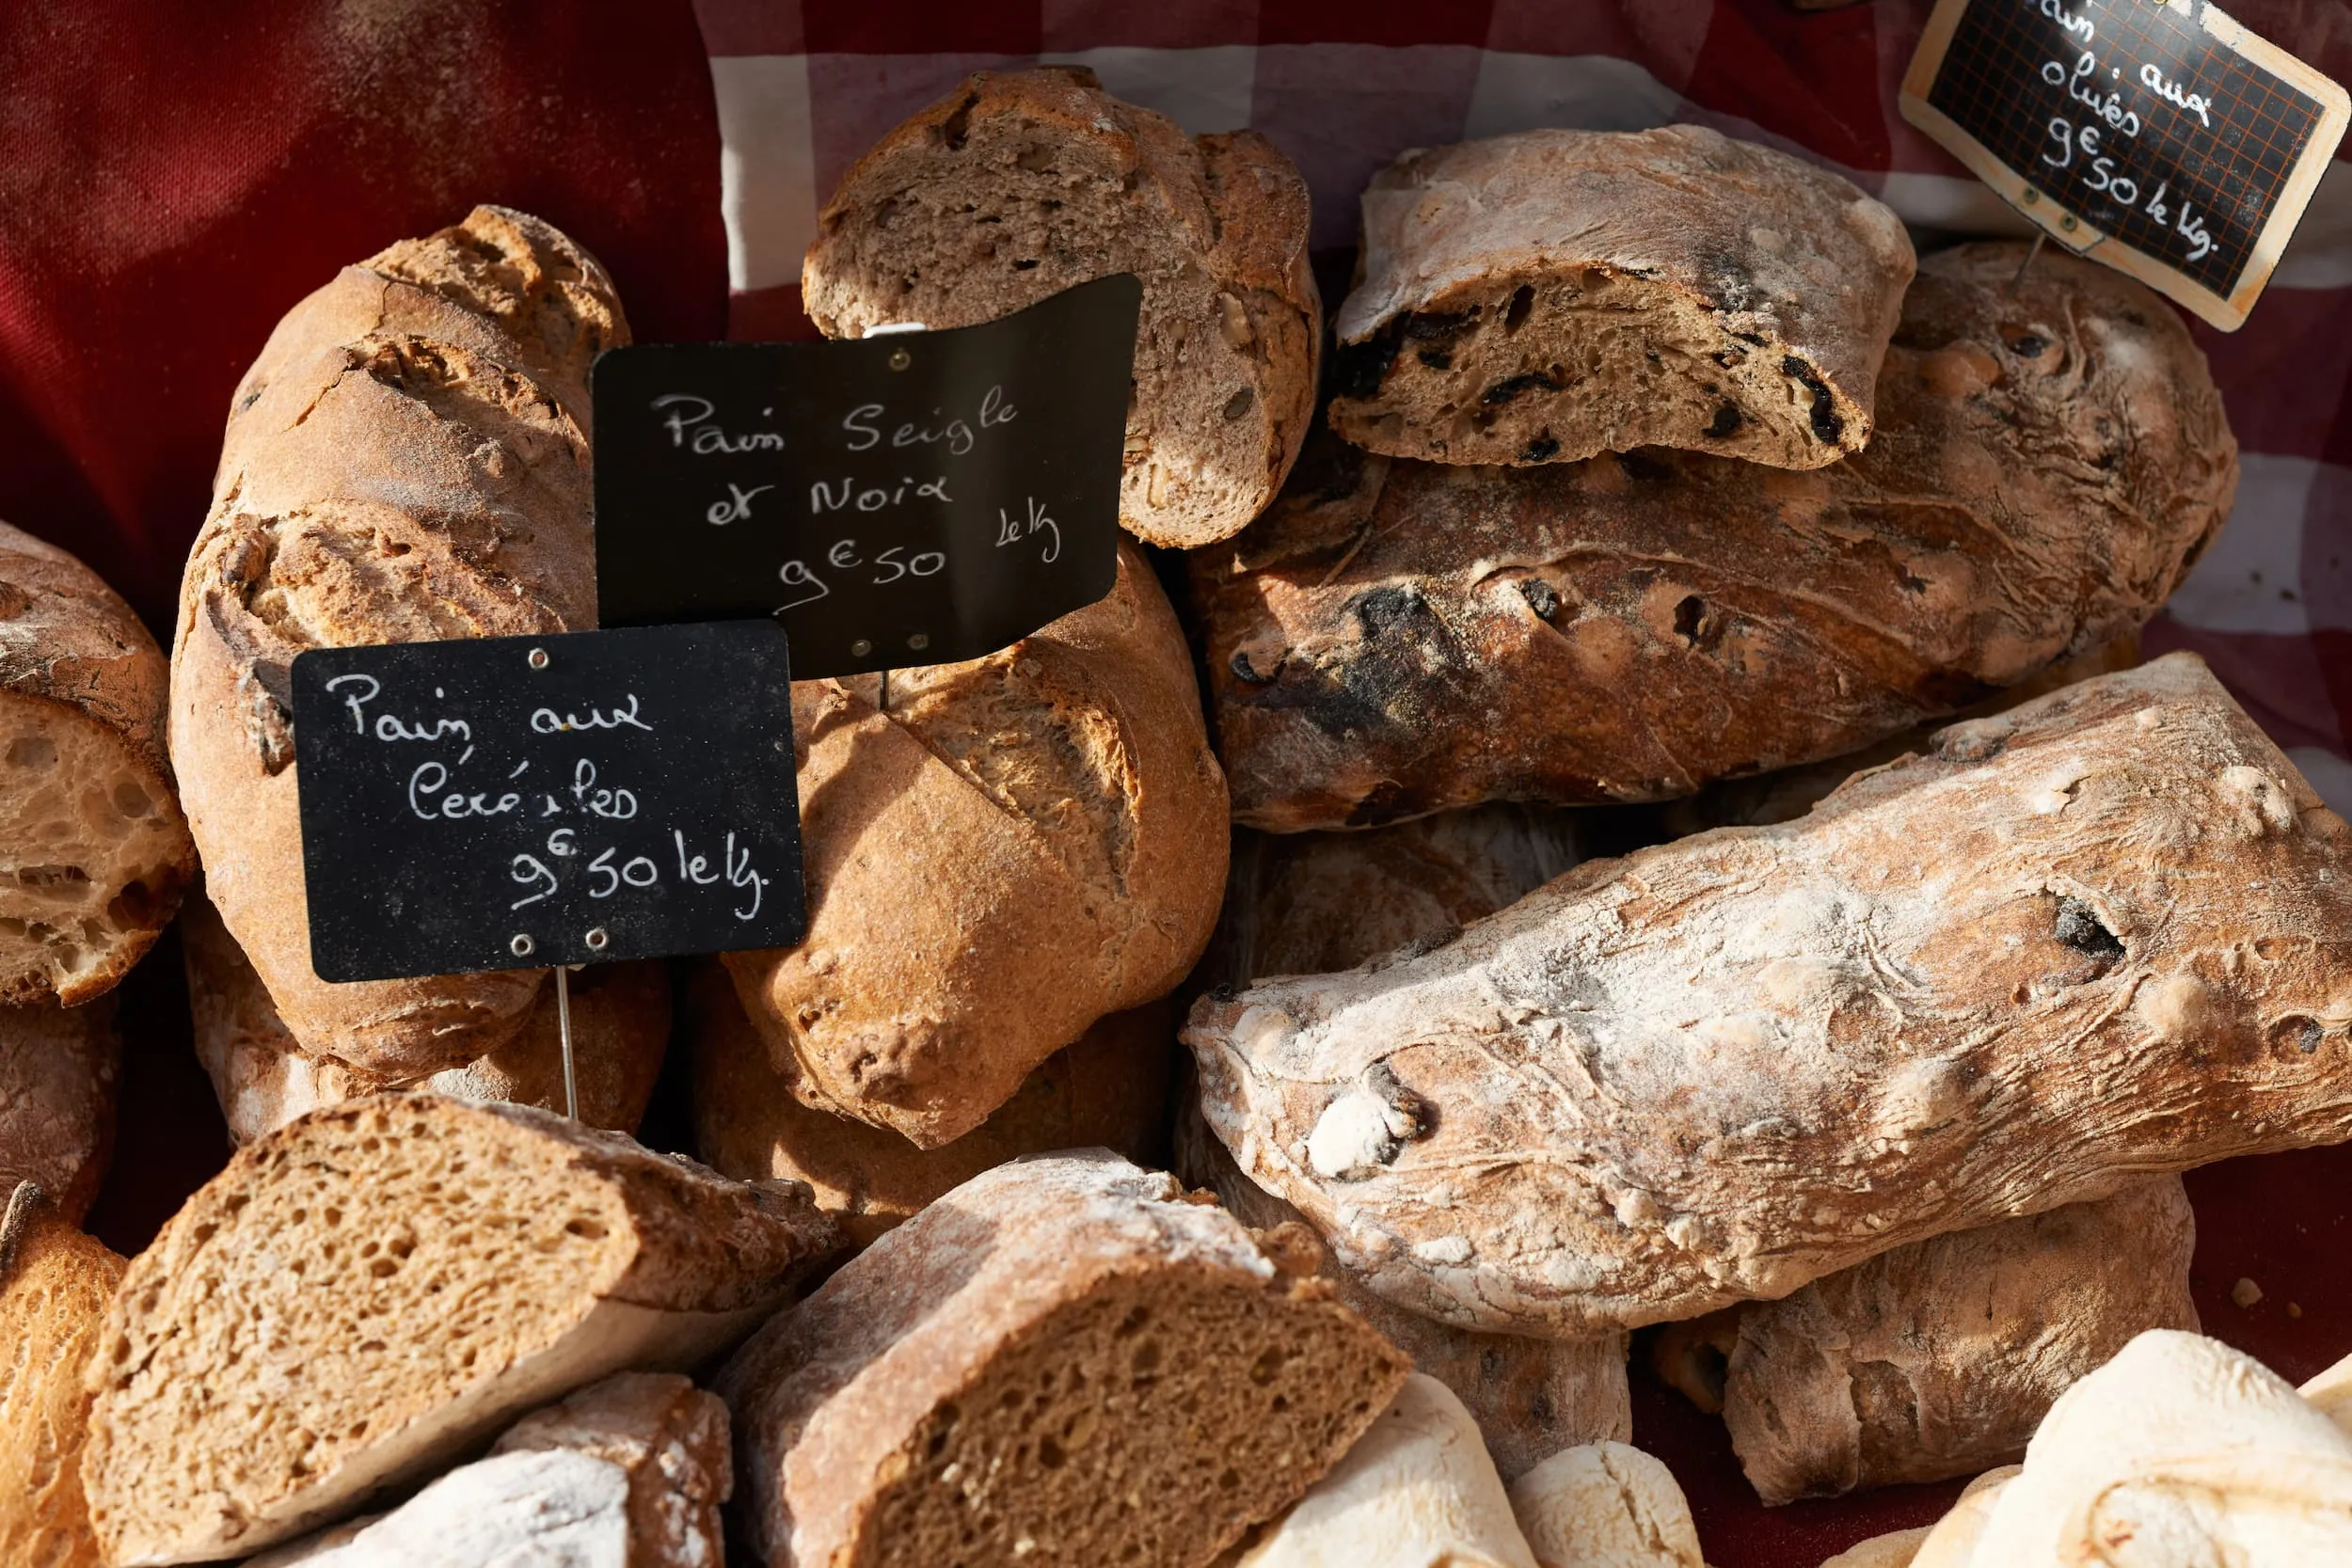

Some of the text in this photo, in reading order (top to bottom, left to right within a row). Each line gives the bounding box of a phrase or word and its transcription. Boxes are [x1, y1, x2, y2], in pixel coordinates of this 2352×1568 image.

[2040, 0, 2212, 128] ain aux
[650, 385, 1020, 455] Pain Seigle
[707, 475, 954, 527] et Noix
[325, 673, 654, 741] Pain aux
